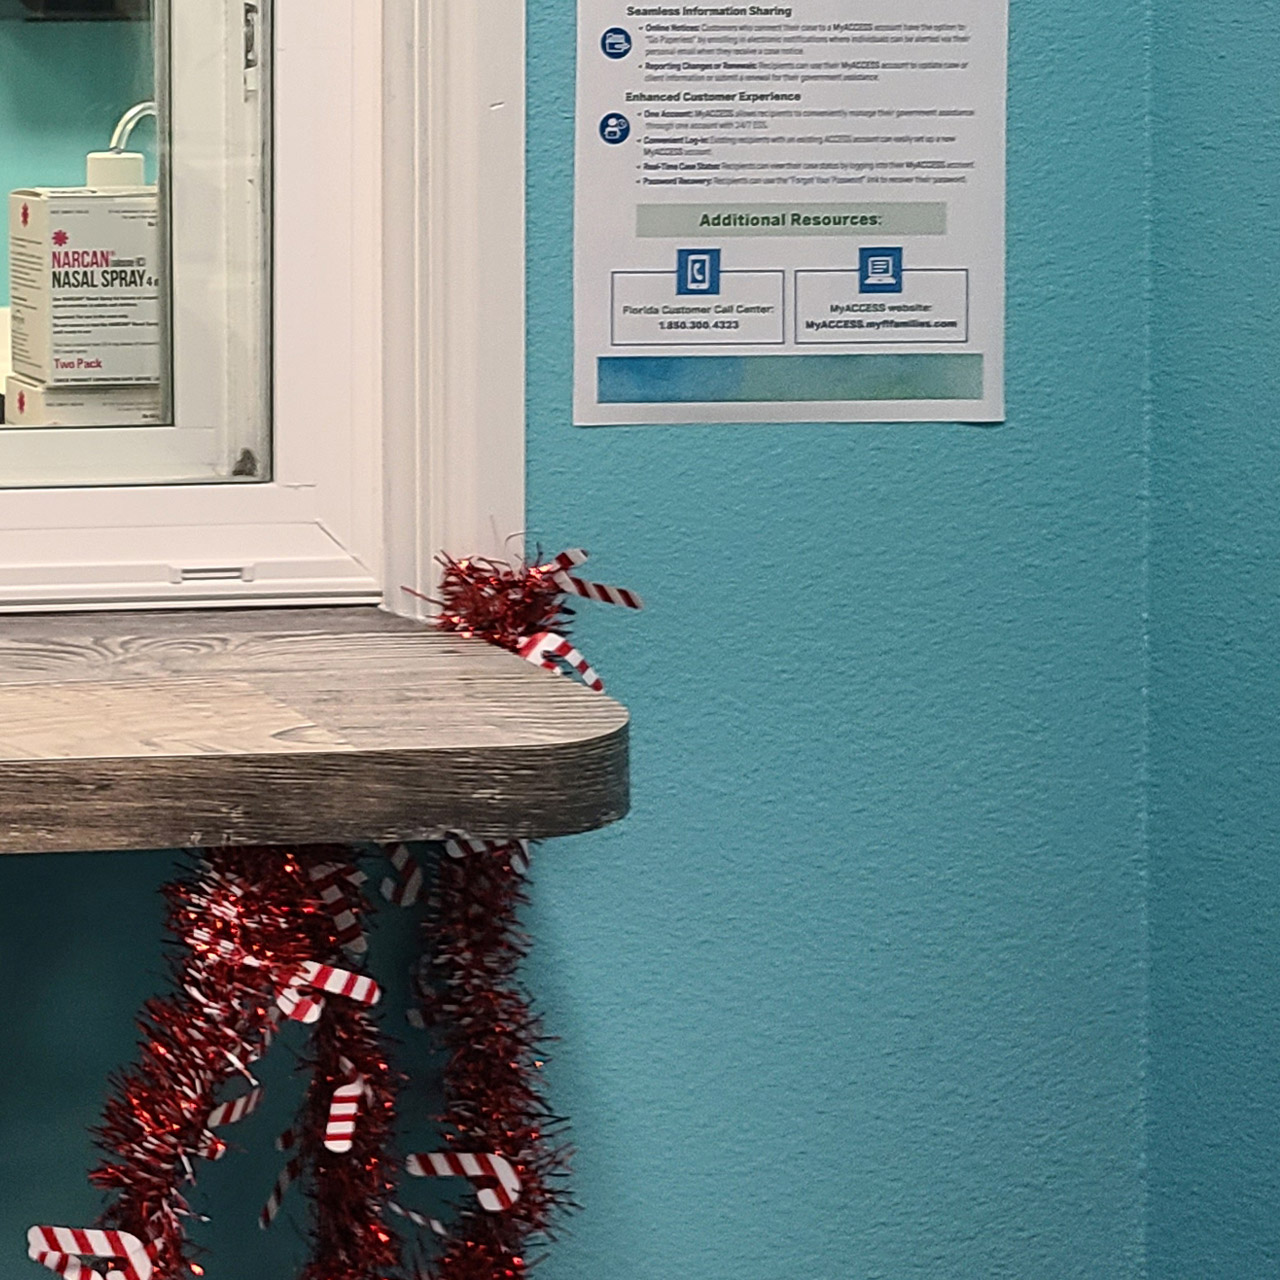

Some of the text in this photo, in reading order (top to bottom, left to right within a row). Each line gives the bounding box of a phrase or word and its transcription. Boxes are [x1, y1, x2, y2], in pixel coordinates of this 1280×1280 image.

[627, 6, 793, 18] Seamless Information Sharing
[625, 91, 801, 103] Enhanced Customer Experience
[699, 213, 882, 227] Additional Resources:
[52, 270, 98, 288] NASAL
[101, 270, 146, 288] SPRAY
[54, 358, 102, 369] Two Pack
